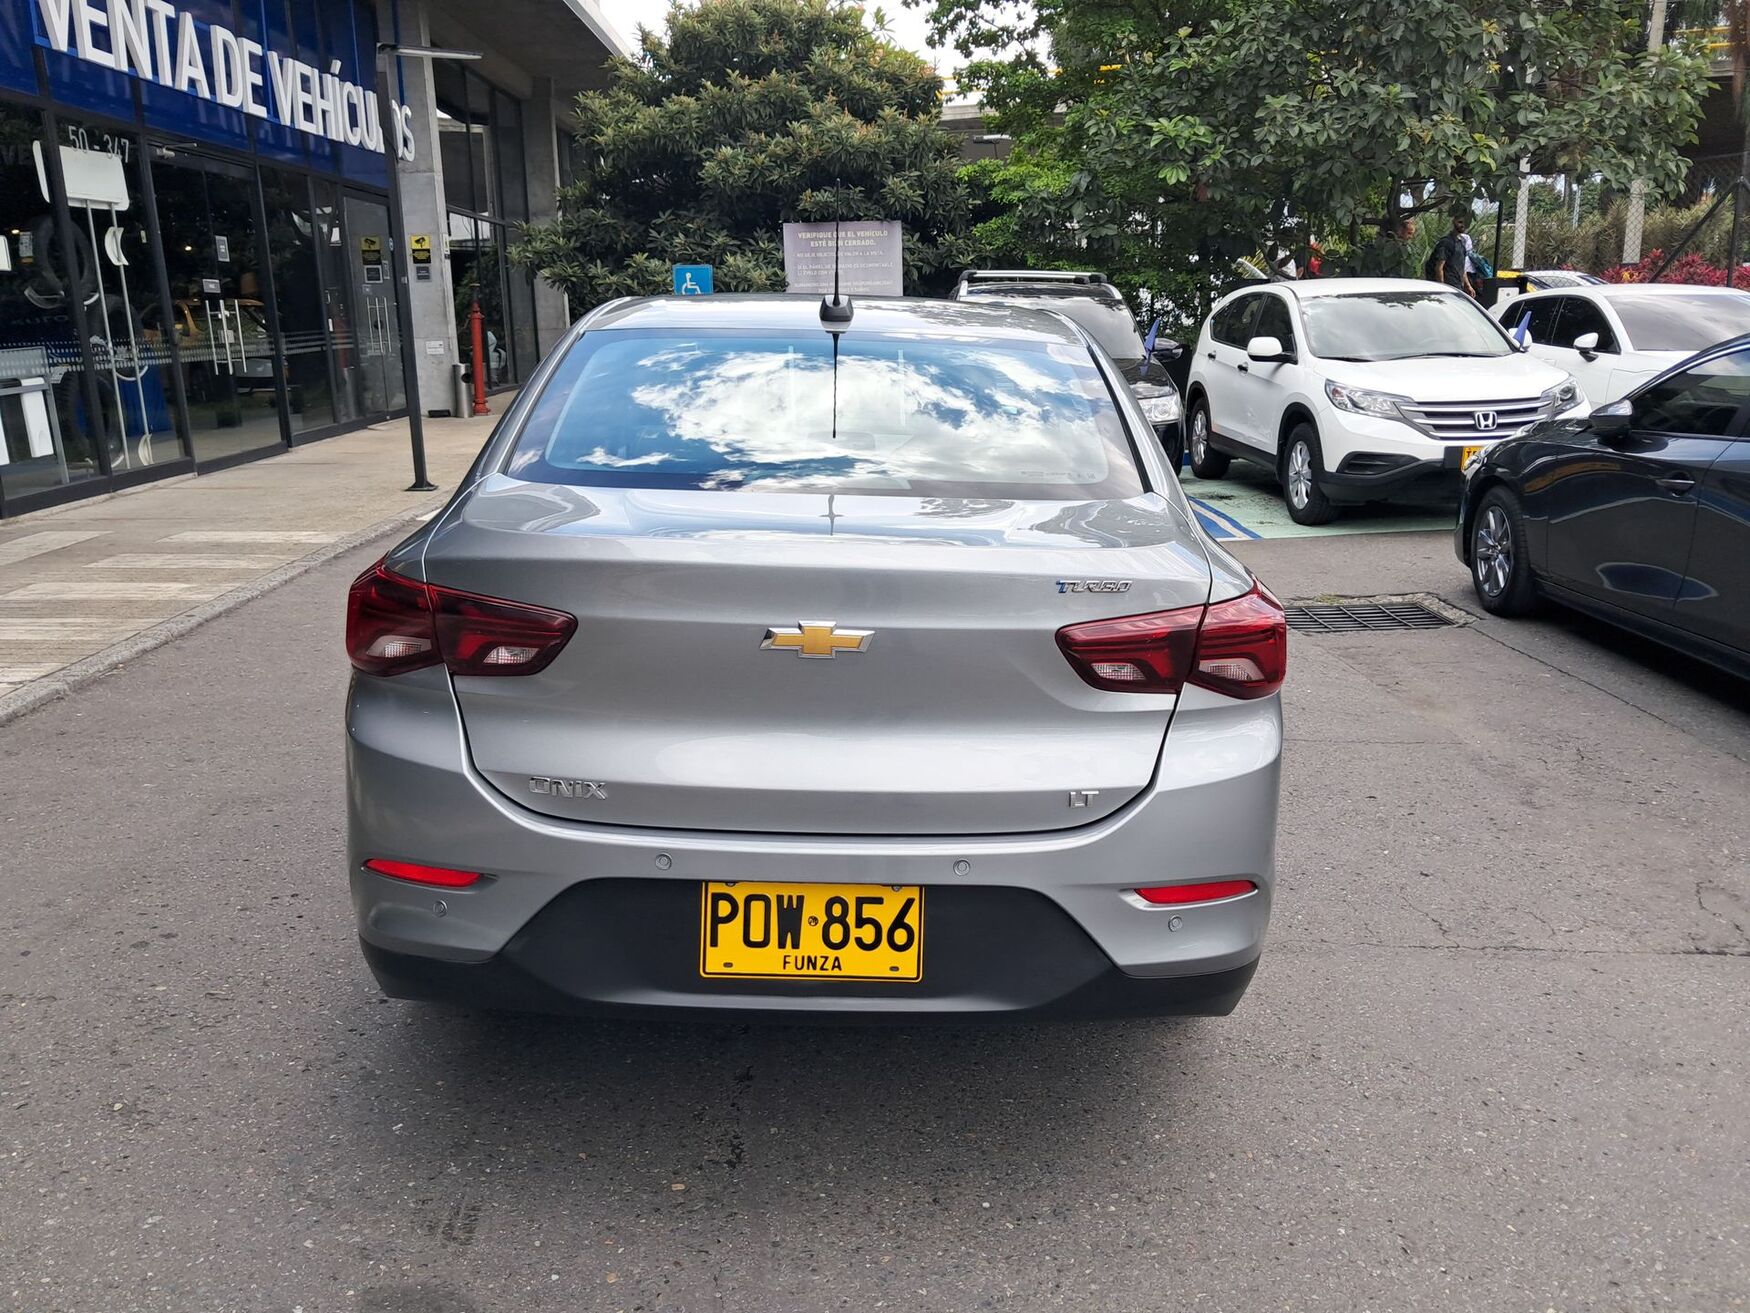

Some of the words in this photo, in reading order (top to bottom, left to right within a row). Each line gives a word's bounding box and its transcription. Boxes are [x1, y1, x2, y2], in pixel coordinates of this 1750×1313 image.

[38, 0, 211, 100] VENTA
[210, 25, 267, 119] DE
[68, 125, 90, 153] 50
[847, 230, 856, 238] EL
[1056, 580, 1133, 593] TURBO
[529, 776, 608, 800] ONIX
[1069, 790, 1099, 808] LT
[709, 892, 805, 950] POW
[821, 895, 916, 952] 856
[782, 954, 843, 972] FUNZA
